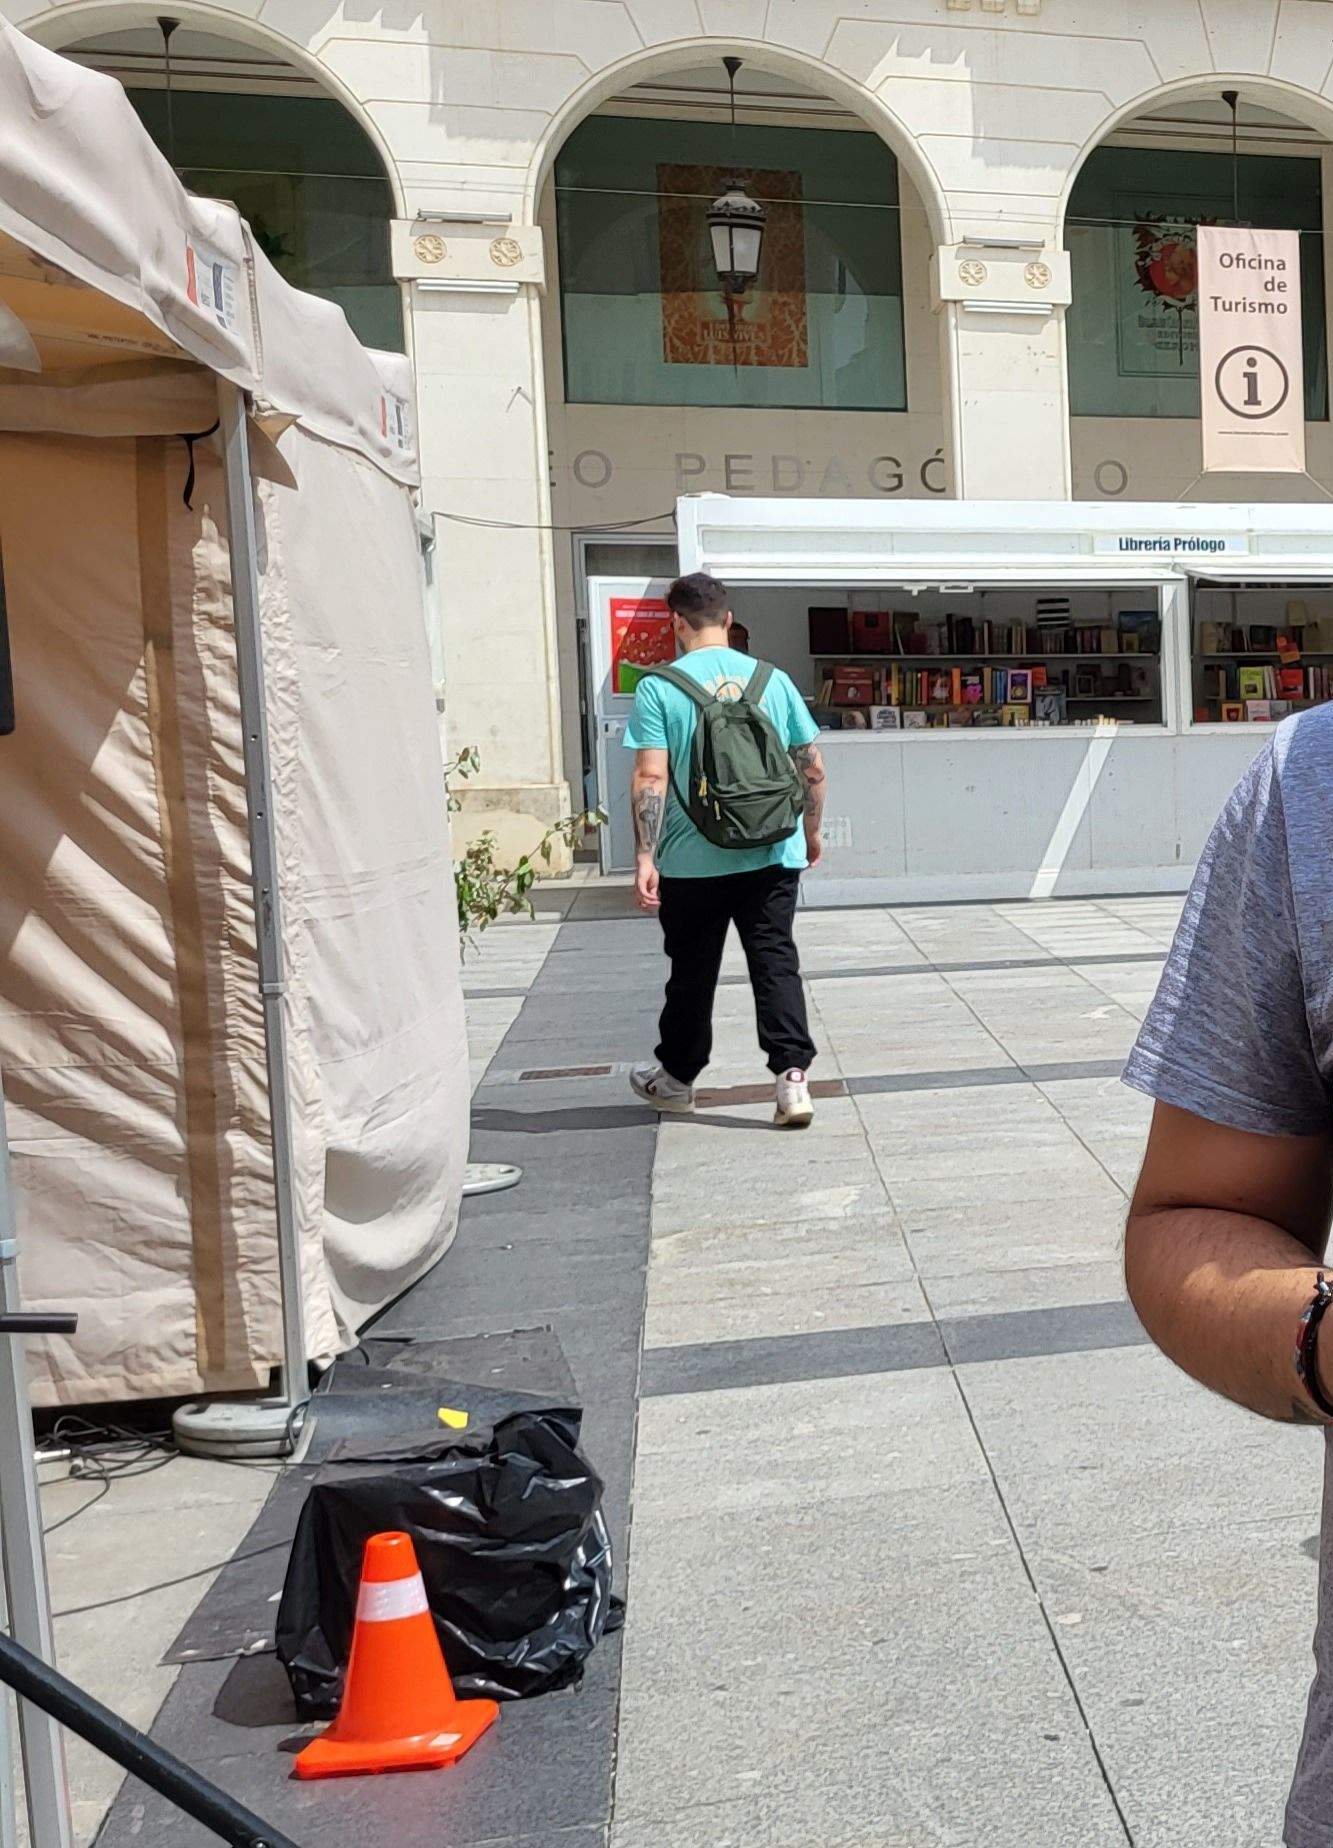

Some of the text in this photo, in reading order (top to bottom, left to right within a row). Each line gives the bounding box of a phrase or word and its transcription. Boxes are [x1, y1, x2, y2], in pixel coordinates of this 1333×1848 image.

[1219, 252, 1287, 271] Oficina
[1263, 275, 1288, 293] de
[1209, 295, 1288, 315] Turismo
[1118, 536, 1226, 553] Librería Prólogo
